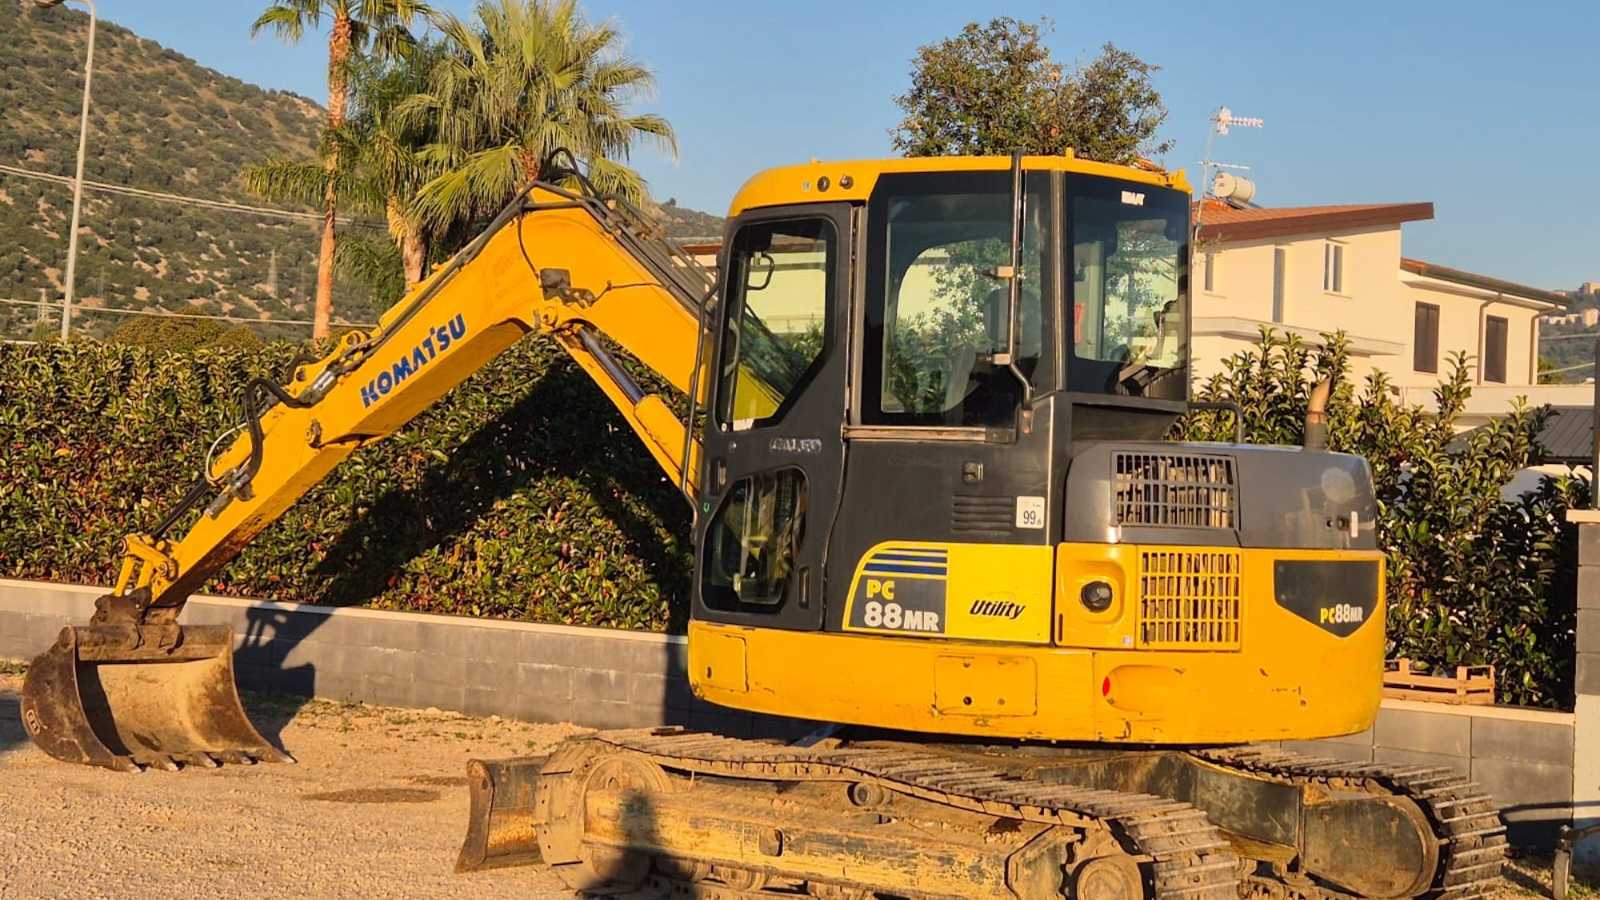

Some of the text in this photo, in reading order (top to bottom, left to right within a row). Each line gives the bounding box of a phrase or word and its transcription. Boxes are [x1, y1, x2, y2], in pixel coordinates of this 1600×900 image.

[360, 313, 466, 408] KOMATSU
[1023, 510, 1037, 525] 99
[866, 579, 895, 601] PC
[864, 600, 940, 632] 88MR
[969, 599, 1027, 621] Utility
[1320, 603, 1363, 624] PC88MR
